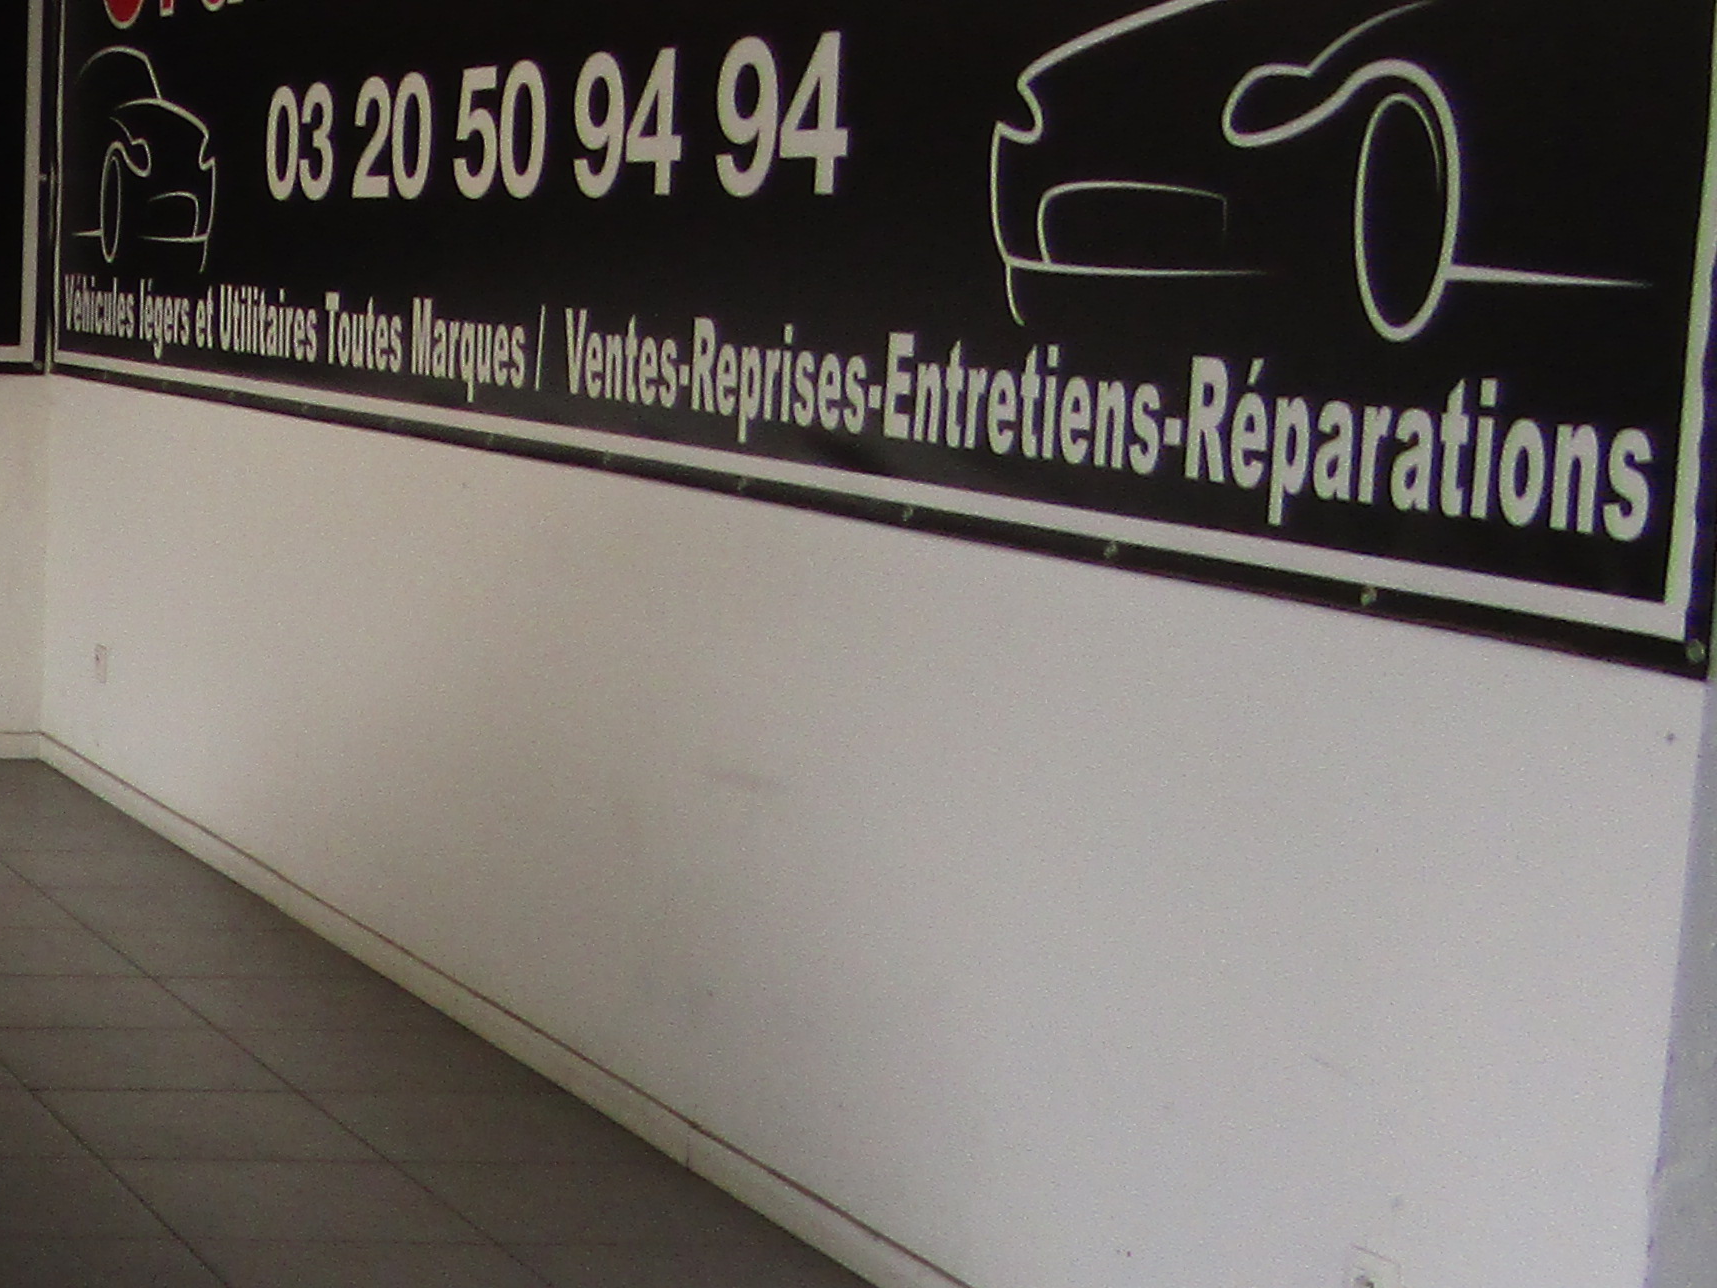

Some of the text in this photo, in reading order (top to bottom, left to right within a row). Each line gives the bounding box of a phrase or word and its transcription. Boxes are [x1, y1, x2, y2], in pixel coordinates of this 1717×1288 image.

[265, 30, 849, 202] 03 20 50 94 94
[65, 273, 134, 339] Véhicules
[140, 278, 189, 360] légers
[195, 286, 213, 351] et
[219, 283, 317, 363] Utilitaires
[325, 291, 402, 374] Toutes
[411, 297, 527, 402] Marques
